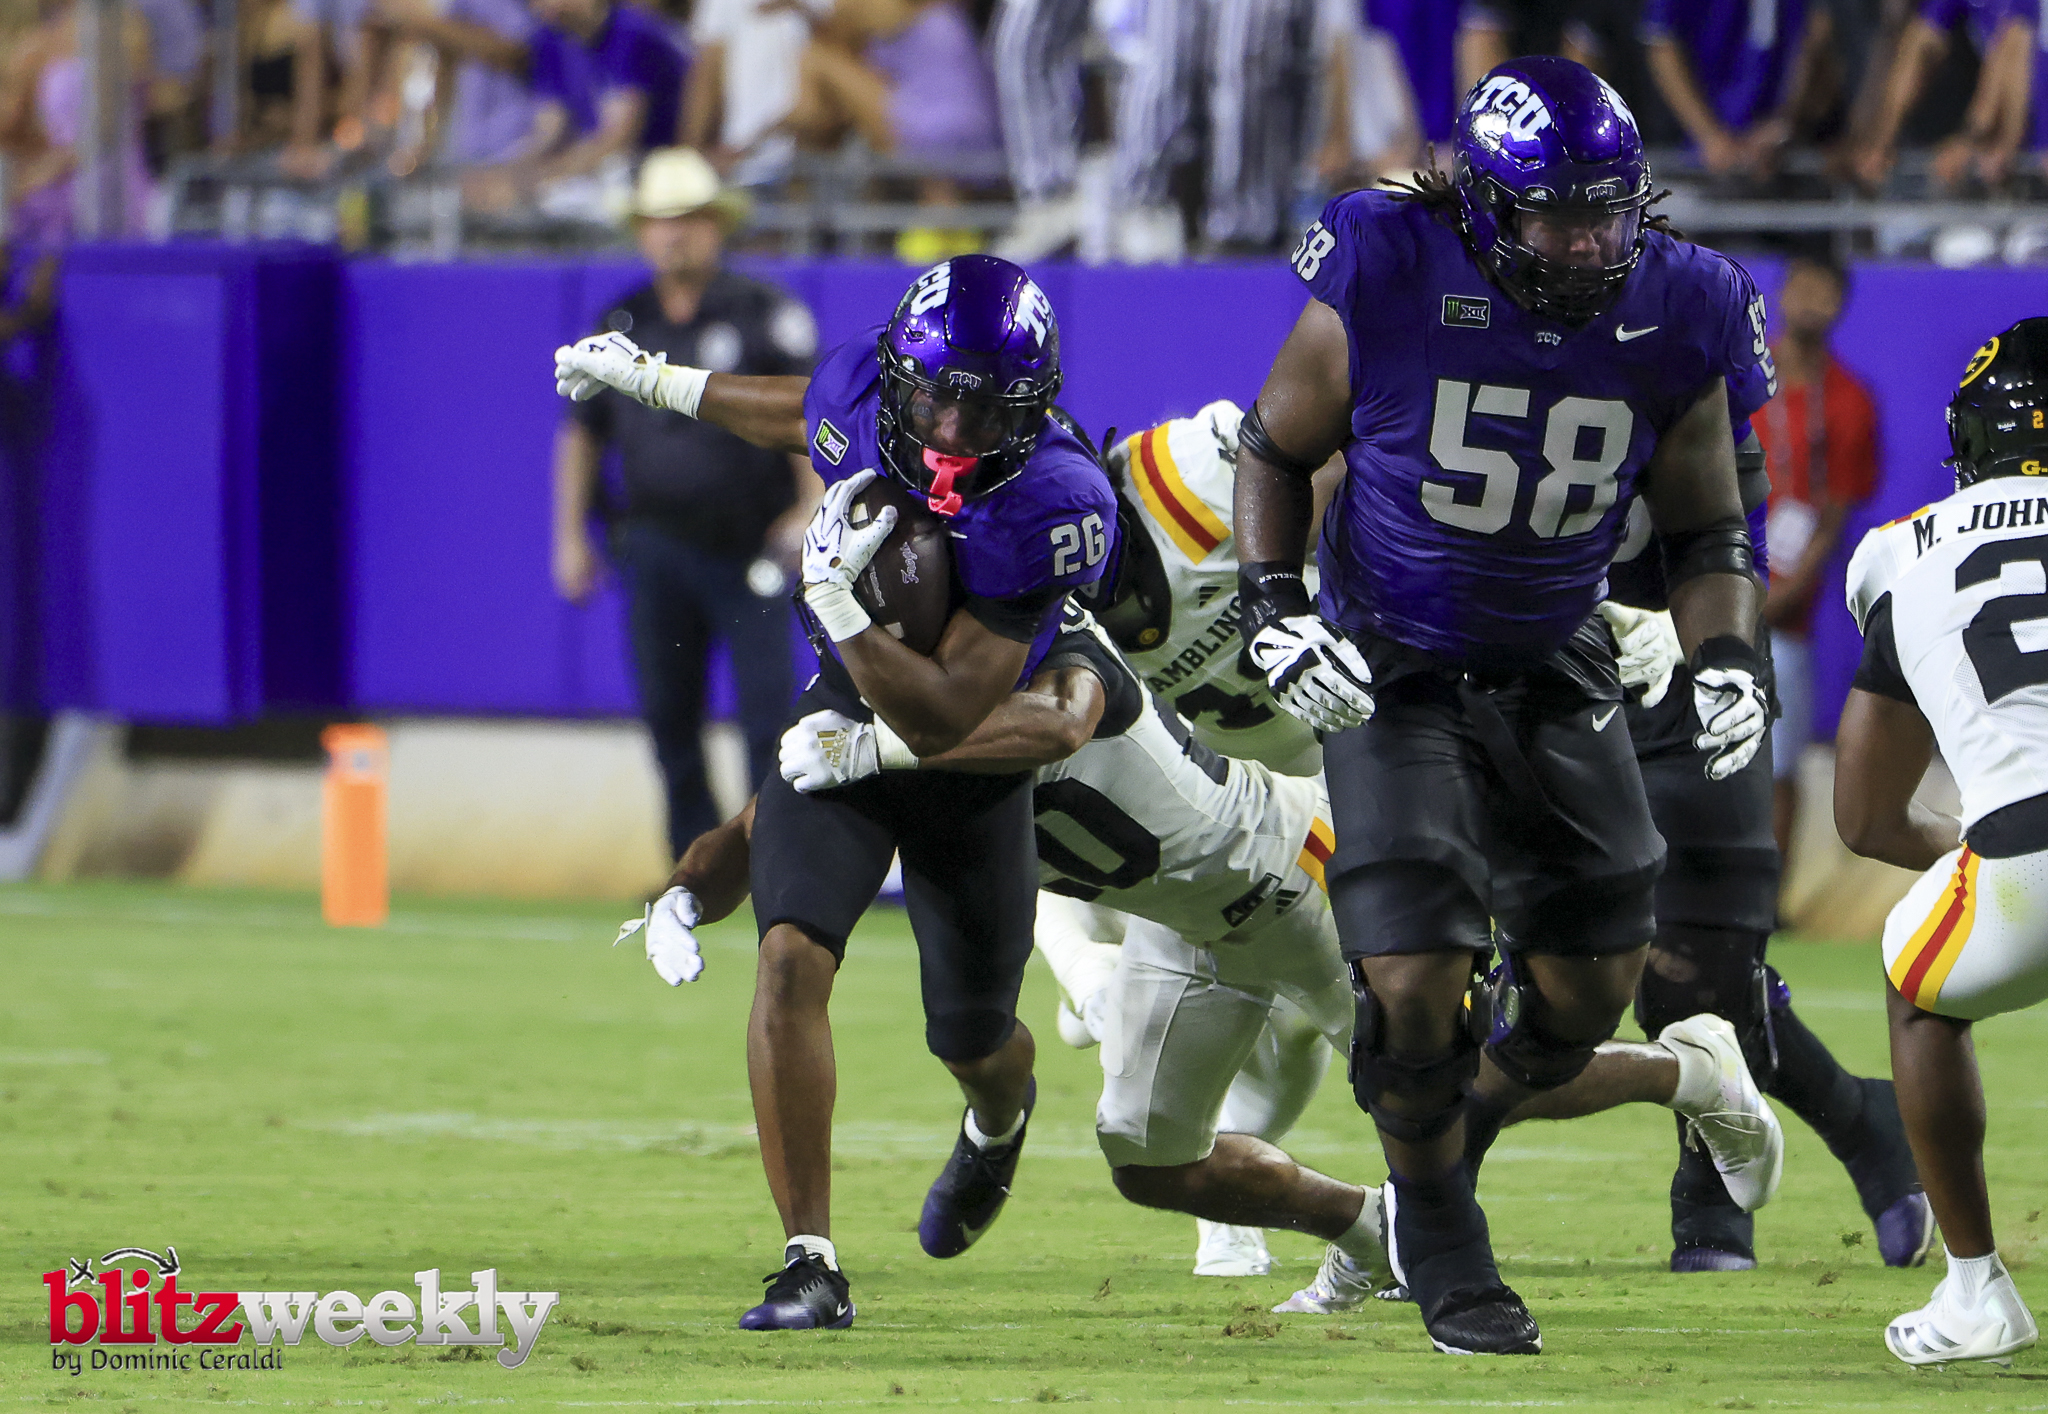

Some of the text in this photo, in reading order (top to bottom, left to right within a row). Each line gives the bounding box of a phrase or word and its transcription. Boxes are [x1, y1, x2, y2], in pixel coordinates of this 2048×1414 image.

[1470, 75, 1552, 143] TCU
[1586, 183, 1617, 201] TCU
[1536, 331, 1562, 347] TCU
[950, 371, 983, 391] TCU
[2033, 411, 2044, 429] 2
[1421, 379, 1634, 539] 58
[1050, 512, 1106, 577] 26
[1913, 514, 1942, 559] M.
